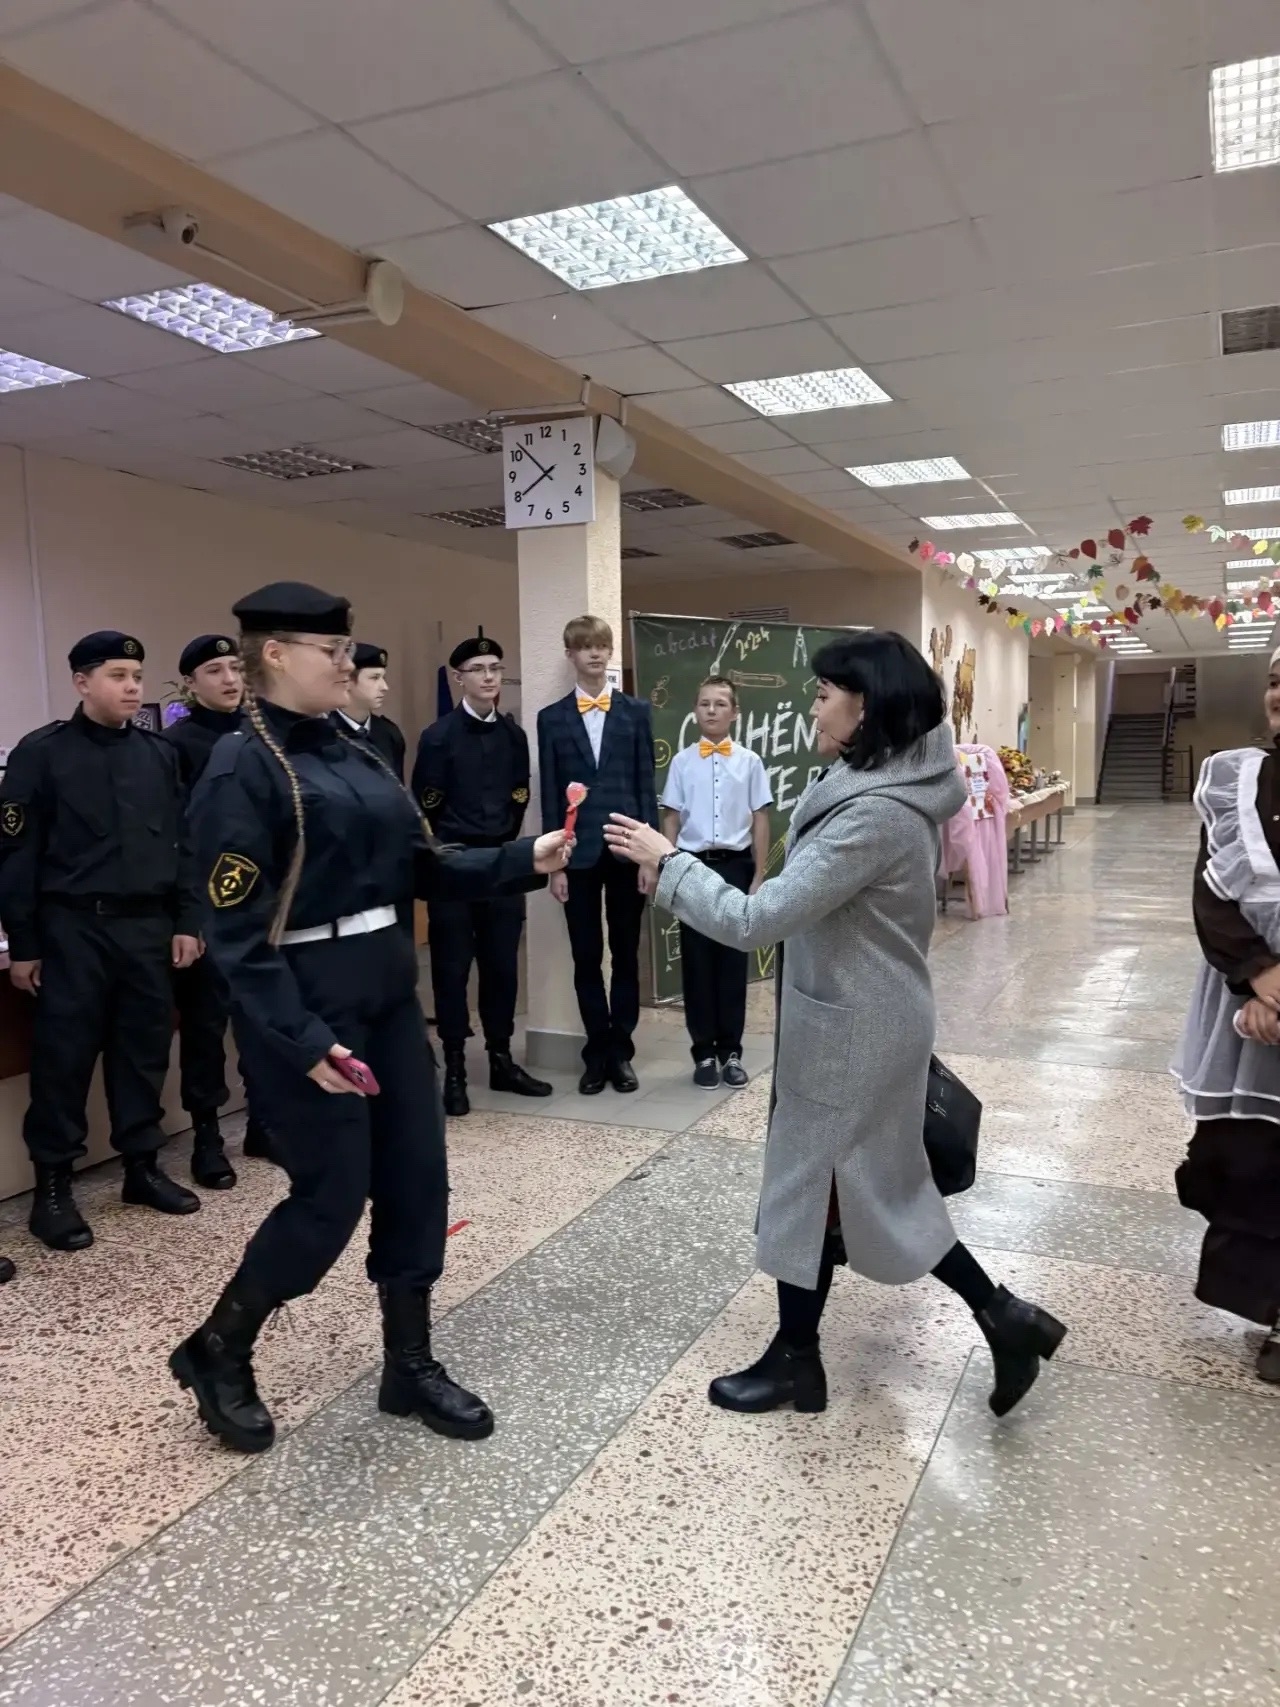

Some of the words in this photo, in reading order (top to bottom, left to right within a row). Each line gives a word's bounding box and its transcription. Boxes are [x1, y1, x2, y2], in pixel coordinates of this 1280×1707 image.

[540, 426, 552, 439] 12
[524, 433, 533, 446] 11
[510, 449, 523, 462] 10
[573, 443, 581, 456] 2
[578, 463, 587, 476] 3
[509, 471, 517, 483] 9
[574, 484, 583, 496] 4
[514, 491, 522, 503] 8
[527, 504, 535, 516] 7
[562, 501, 570, 513] 5
[545, 508, 553, 520] 6
